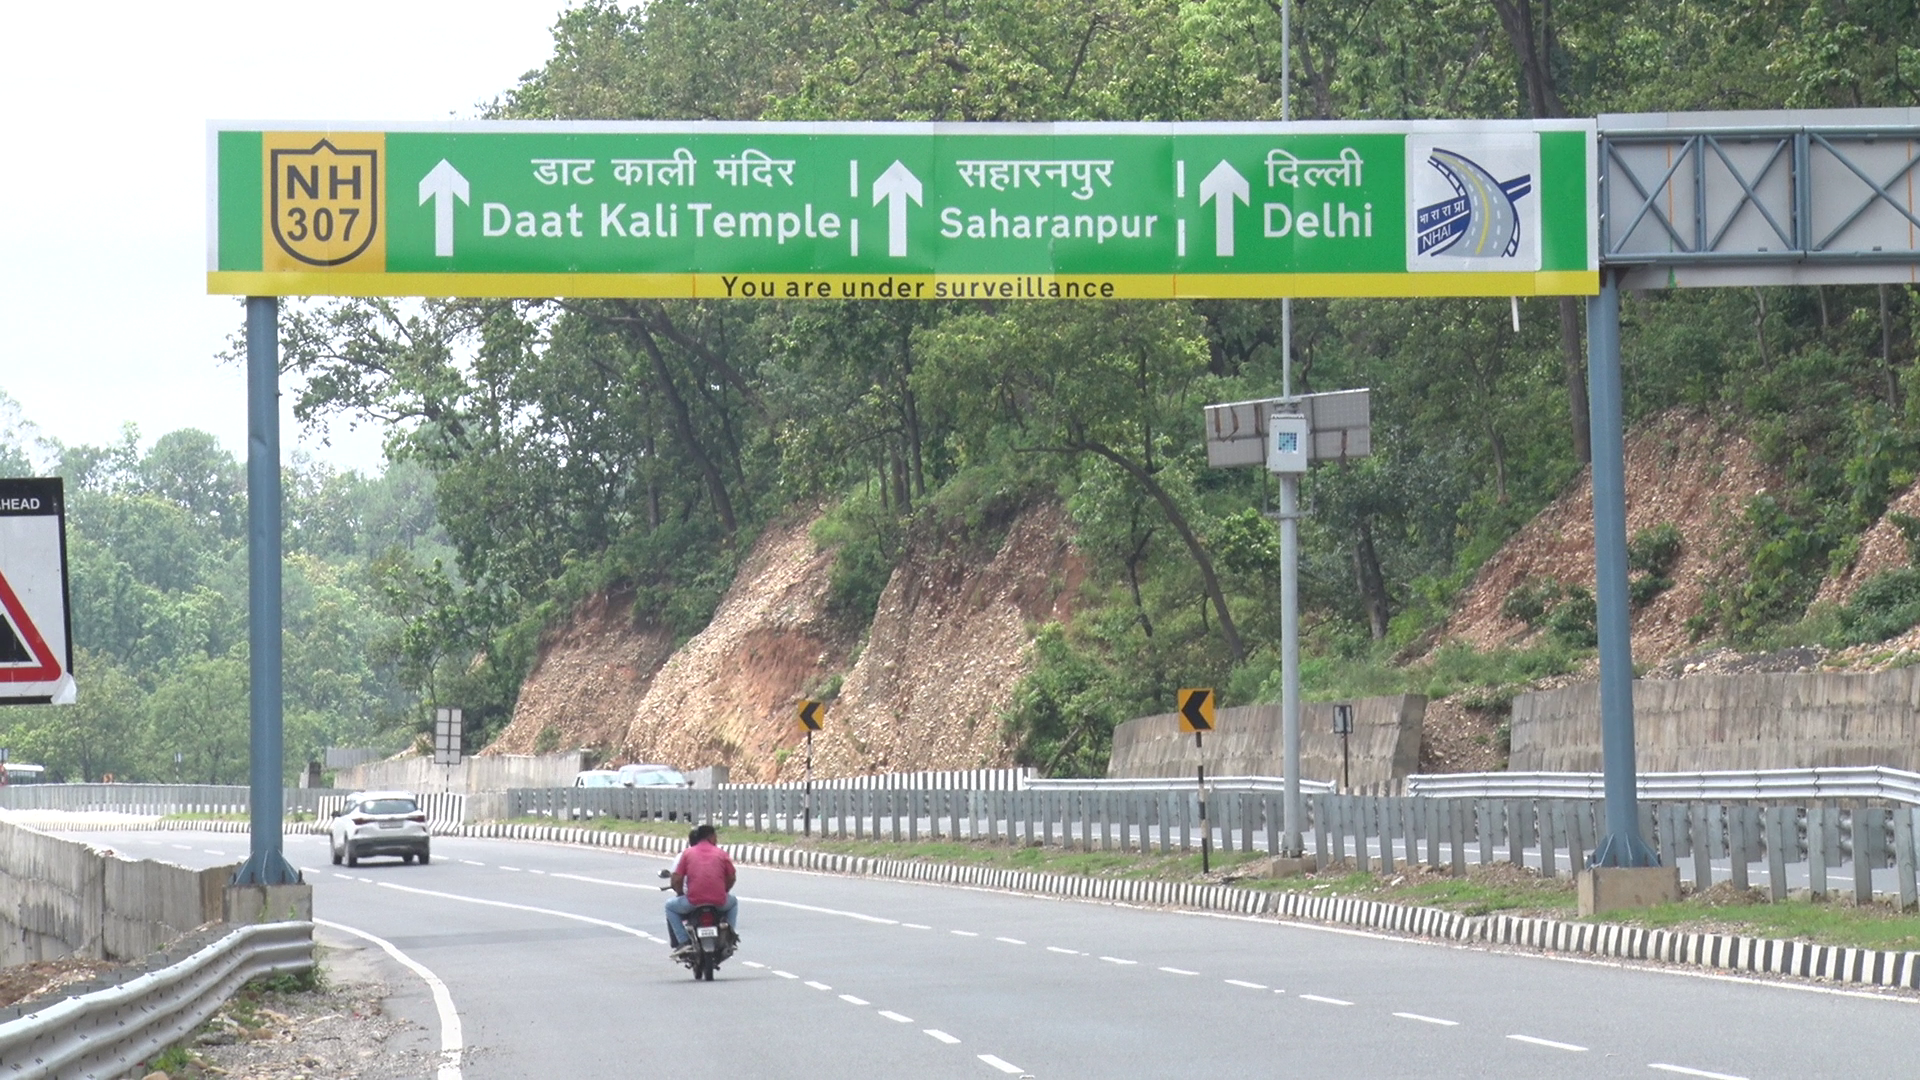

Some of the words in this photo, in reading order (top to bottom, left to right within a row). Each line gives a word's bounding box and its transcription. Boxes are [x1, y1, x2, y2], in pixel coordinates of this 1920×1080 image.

[286, 165, 362, 200] NH
[531, 158, 596, 186] डाट
[611, 147, 698, 187] काली
[713, 148, 797, 188] मंदिर
[956, 159, 1115, 201] सहारनपुर
[1265, 147, 1364, 189] दिल्ली
[286, 207, 360, 242] 307
[483, 202, 584, 238] Daat
[600, 202, 678, 238] Kali
[687, 202, 841, 245] Temple
[941, 206, 1158, 244] Saharanpur
[1264, 202, 1372, 238] Delhi
[1422, 225, 1452, 250] NHAI
[721, 276, 775, 298] You
[786, 281, 832, 298] are
[842, 277, 925, 298] under
[935, 276, 1115, 298] surveillance
[0, 498, 40, 510] HEAD
